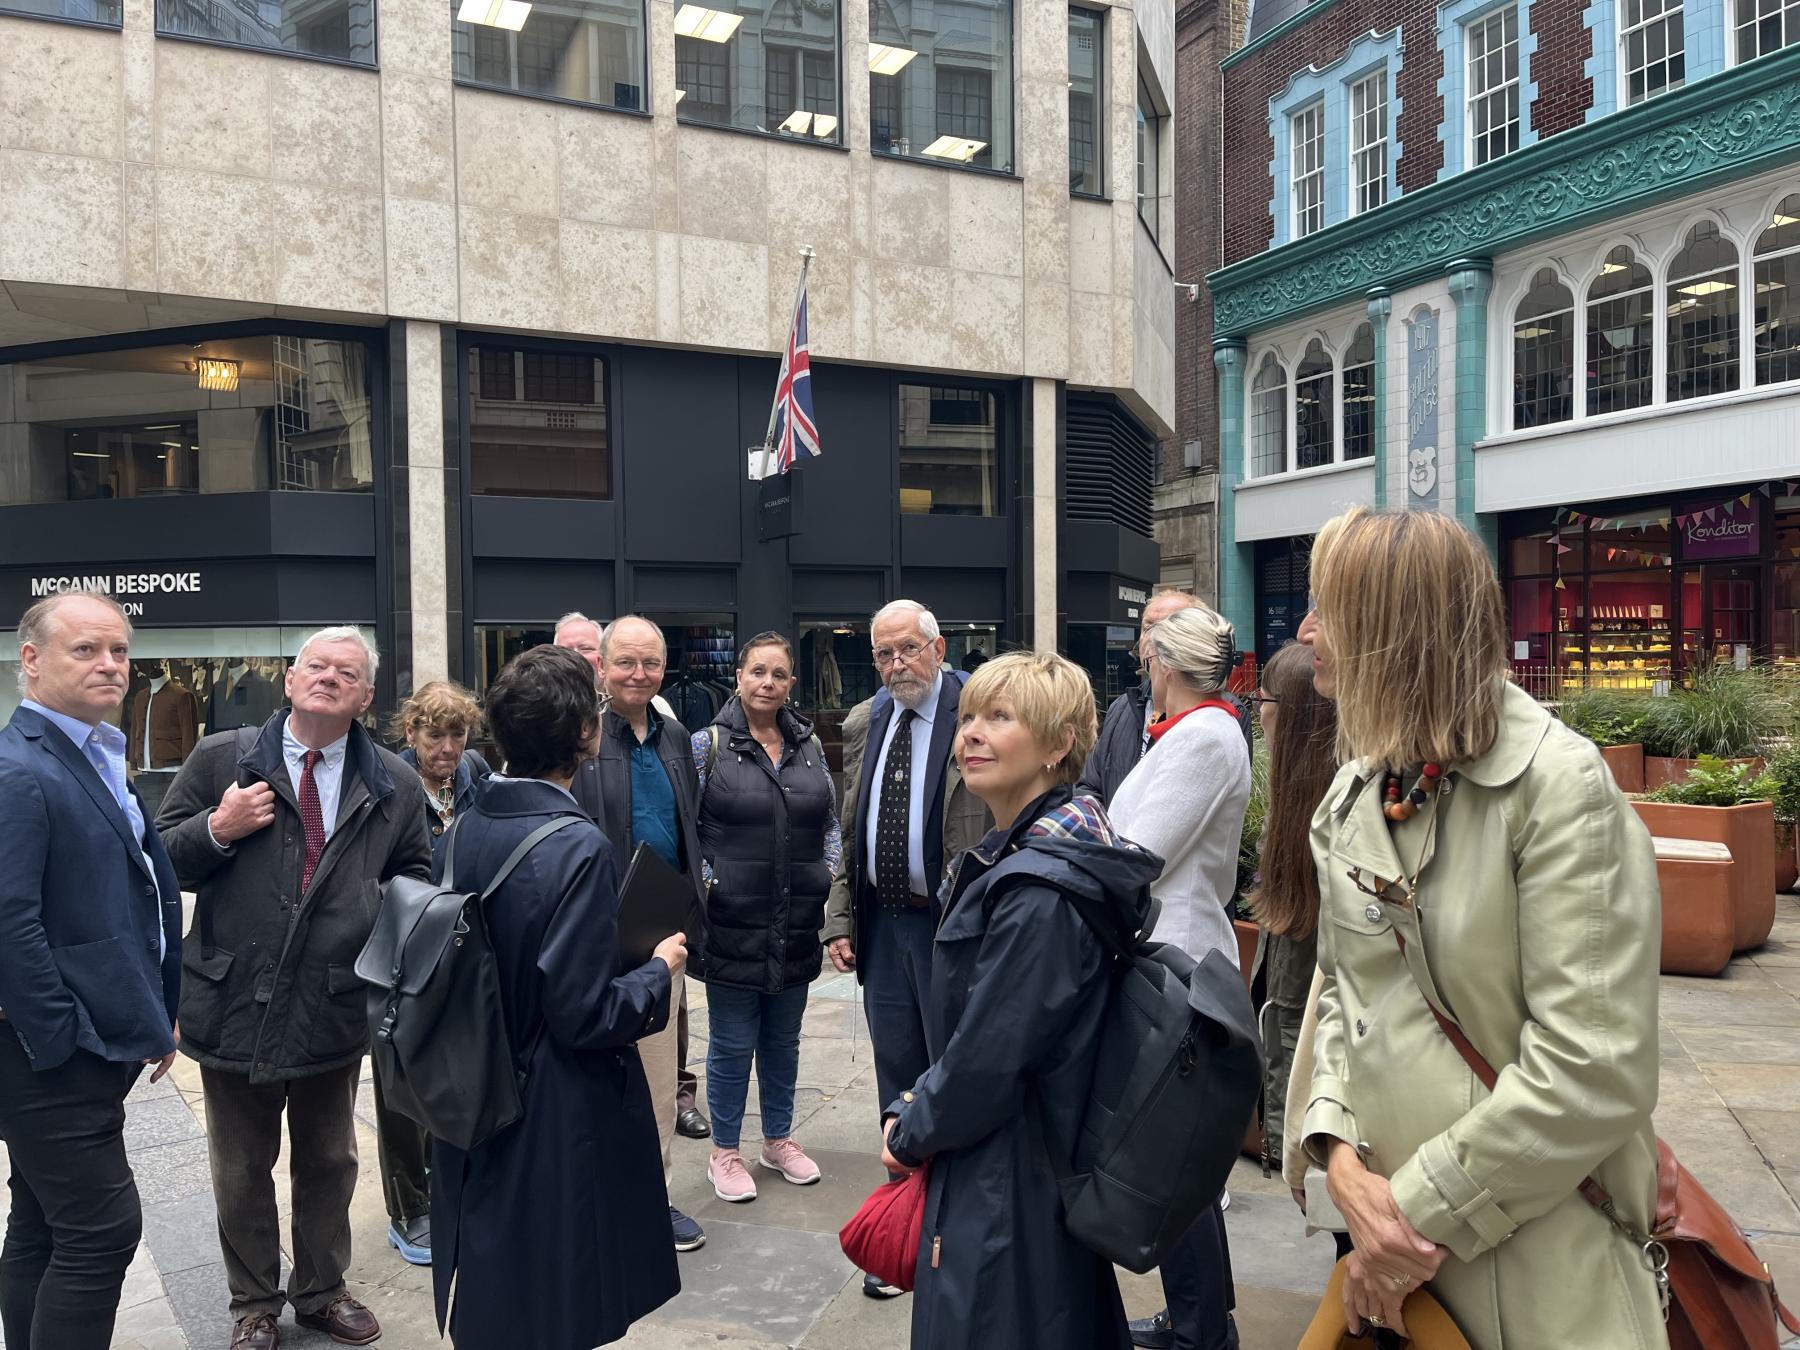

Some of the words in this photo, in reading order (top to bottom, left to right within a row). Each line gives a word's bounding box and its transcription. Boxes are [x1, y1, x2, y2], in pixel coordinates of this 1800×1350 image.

[1408, 383, 1438, 445] HOUSE
[1687, 518, 1755, 545] Konditor
[116, 573, 201, 594] BESPOKE
